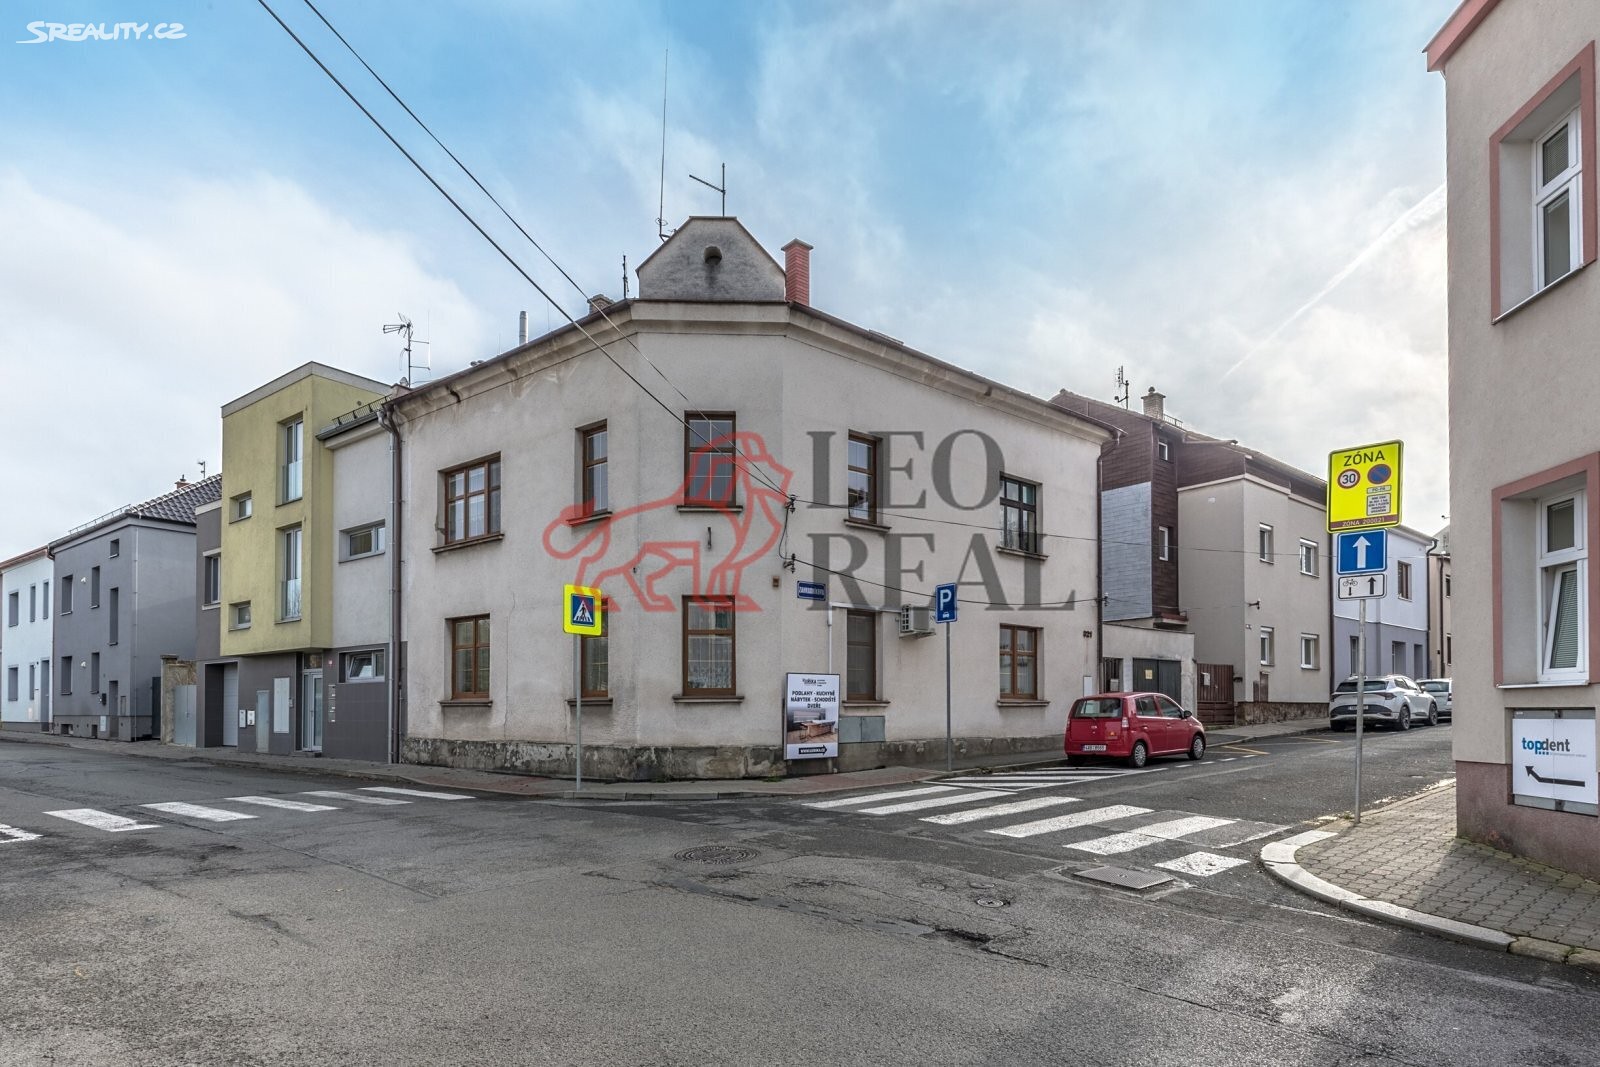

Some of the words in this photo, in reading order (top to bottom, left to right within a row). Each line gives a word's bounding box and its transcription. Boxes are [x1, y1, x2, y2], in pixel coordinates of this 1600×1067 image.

[1344, 450, 1386, 467] ZÓNA
[1342, 473, 1356, 485] 30
[1342, 519, 1360, 527] ZÓNA
[939, 589, 952, 611] P
[1522, 737, 1571, 755] topdent
